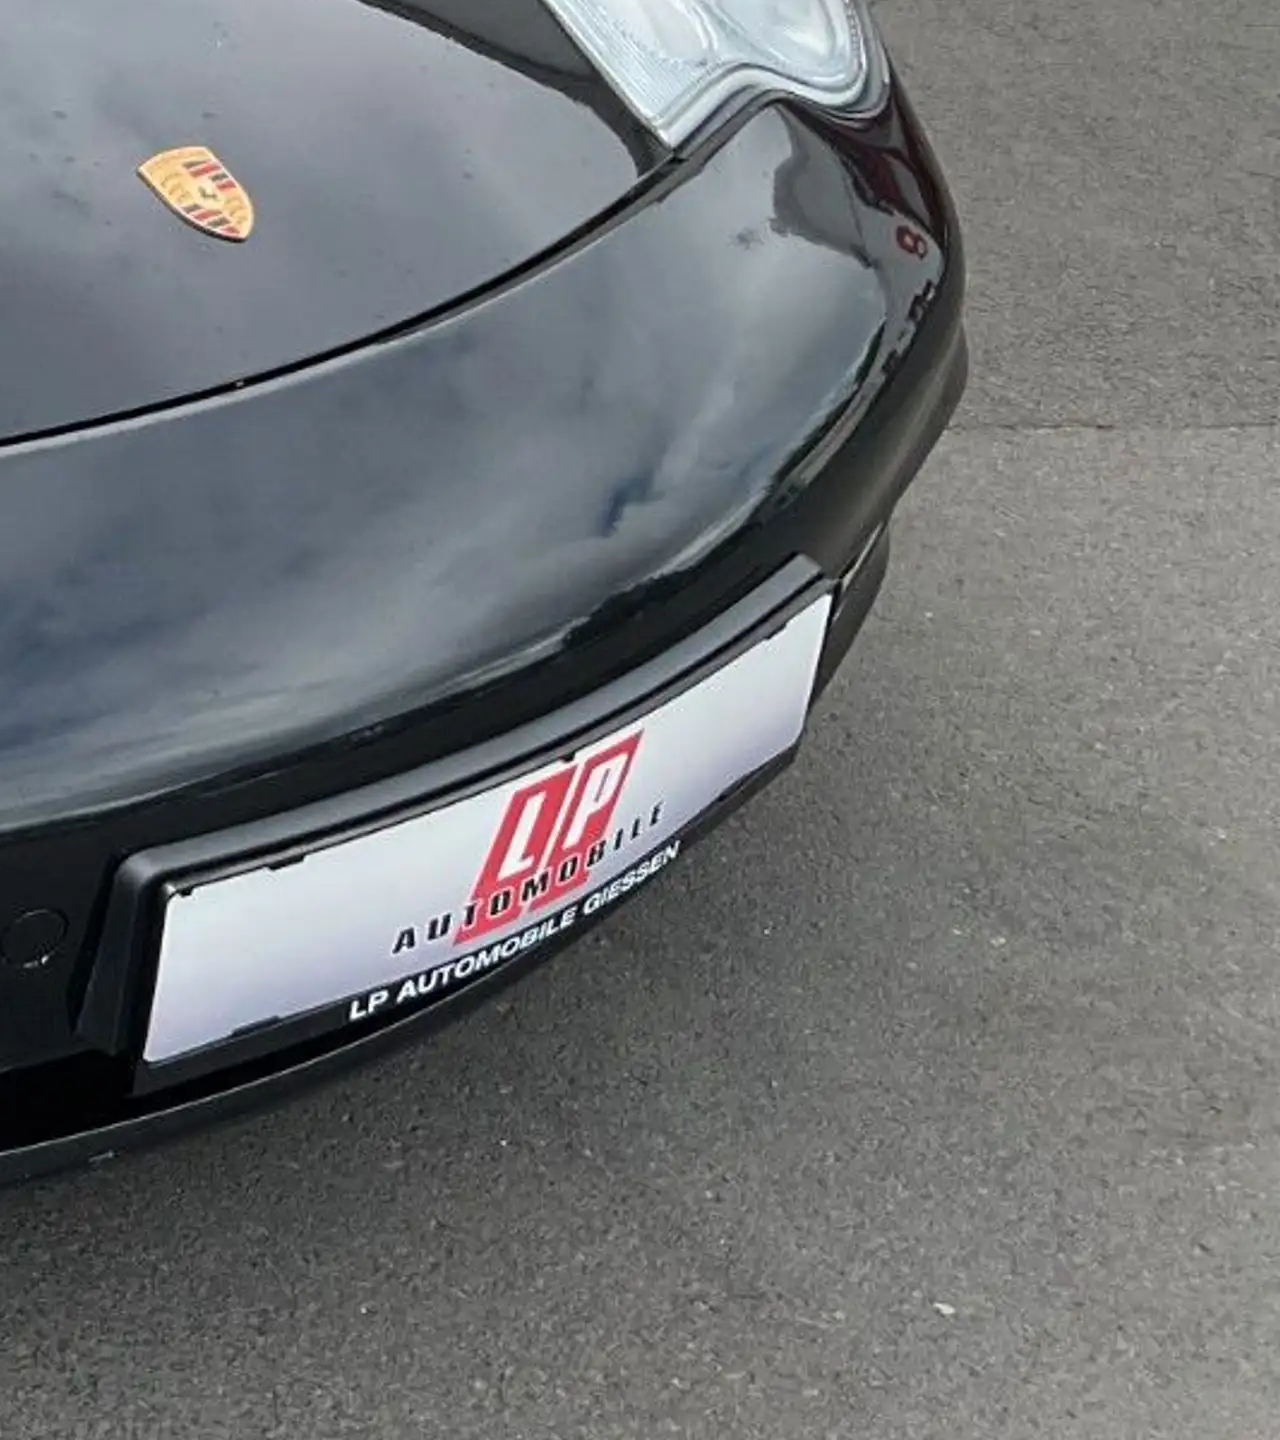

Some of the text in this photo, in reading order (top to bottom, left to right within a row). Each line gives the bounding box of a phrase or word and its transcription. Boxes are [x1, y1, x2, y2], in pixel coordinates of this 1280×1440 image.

[348, 840, 683, 1022] LP AUTOMOBILE GIESSEN
[391, 800, 665, 955] AUTOMOBILE
